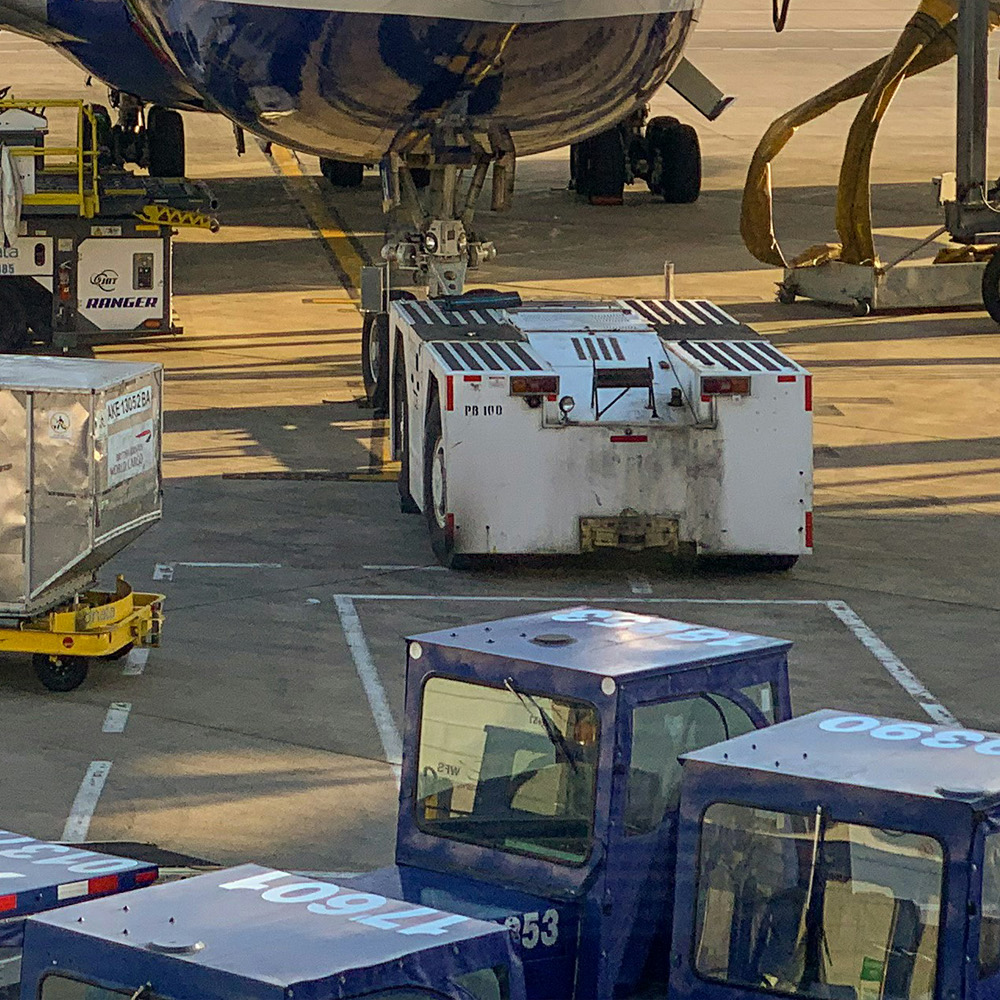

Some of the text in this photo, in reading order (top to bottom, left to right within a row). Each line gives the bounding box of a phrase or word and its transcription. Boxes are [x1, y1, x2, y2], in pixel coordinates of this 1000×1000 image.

[86, 297, 158, 309] RANGER
[464, 405, 479, 416] PB
[219, 870, 471, 935] 17601
